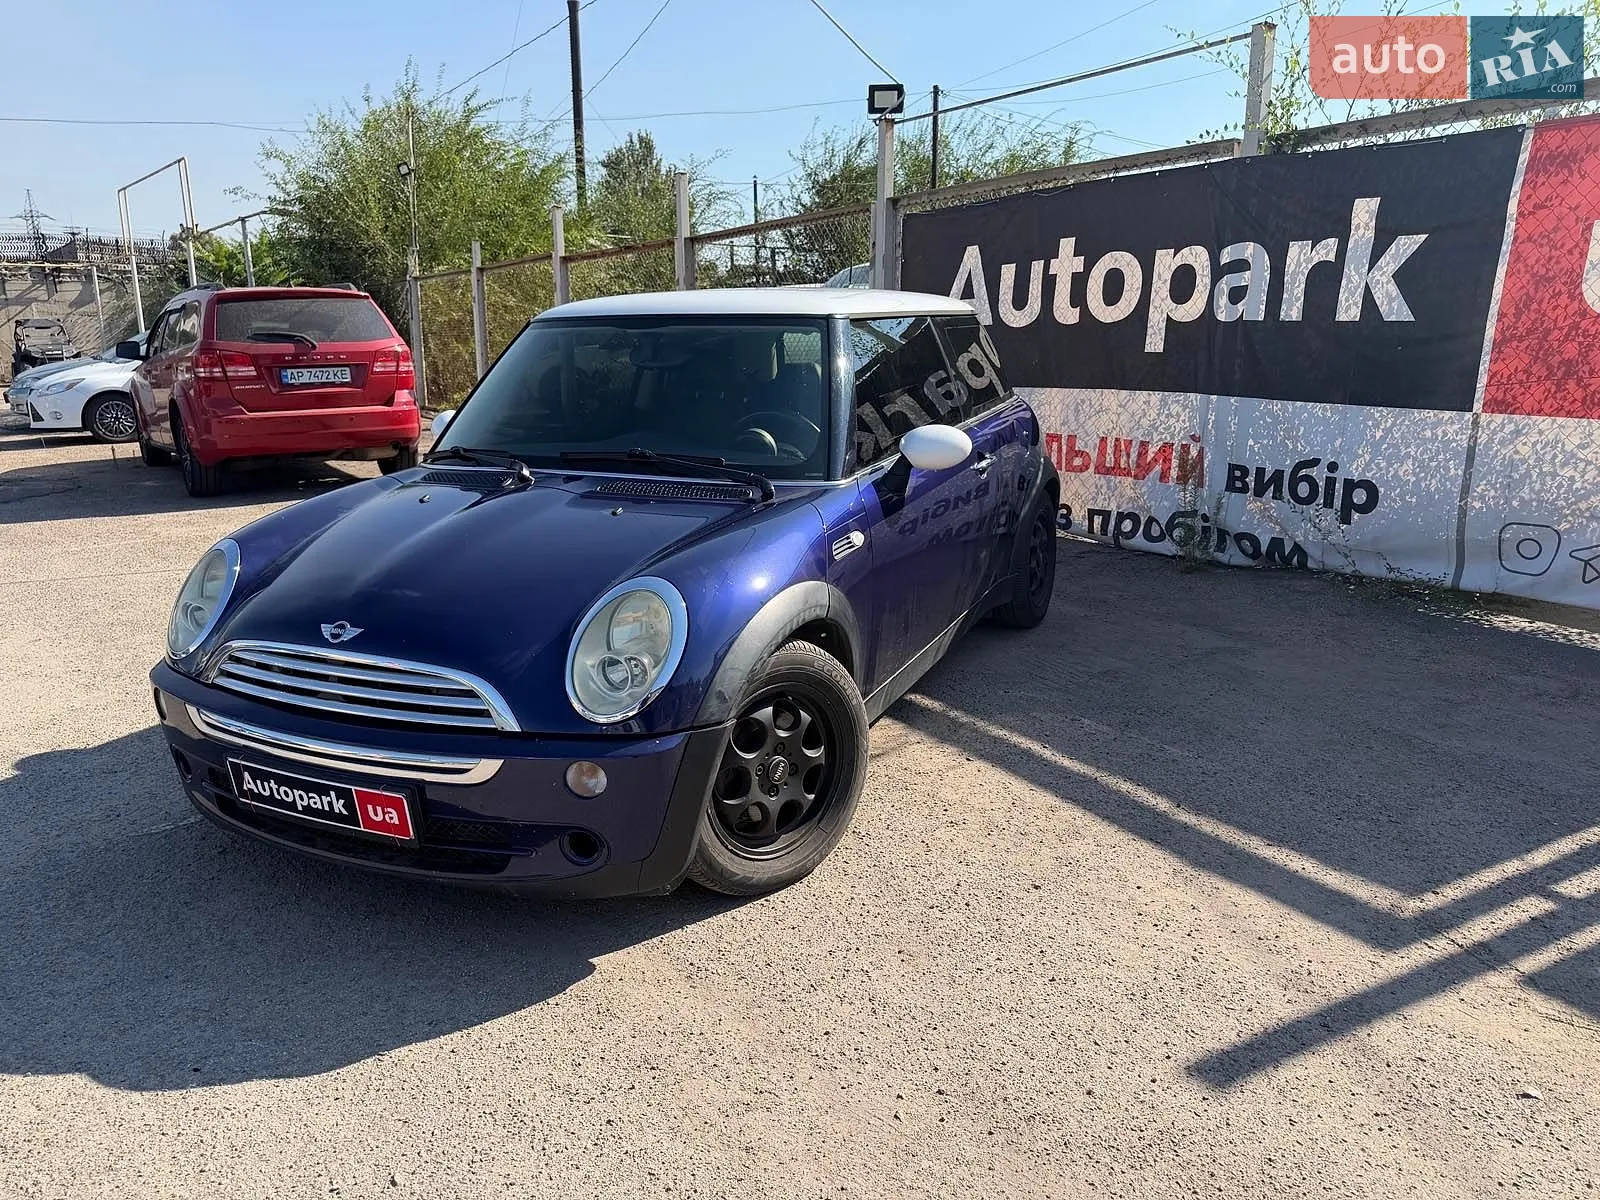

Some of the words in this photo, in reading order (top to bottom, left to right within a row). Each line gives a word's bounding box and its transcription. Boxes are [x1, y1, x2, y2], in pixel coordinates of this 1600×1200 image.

[949, 197, 1429, 353] Autopark
[289, 371, 304, 382] AP
[308, 370, 331, 381] 7472
[332, 369, 349, 380] KE
[1045, 432, 1204, 488] льший
[1225, 457, 1379, 525] вибір
[1087, 508, 1308, 570] пробігом
[243, 771, 348, 815] Autopark
[366, 803, 399, 825] ua
[773, 762, 785, 781] MINI
